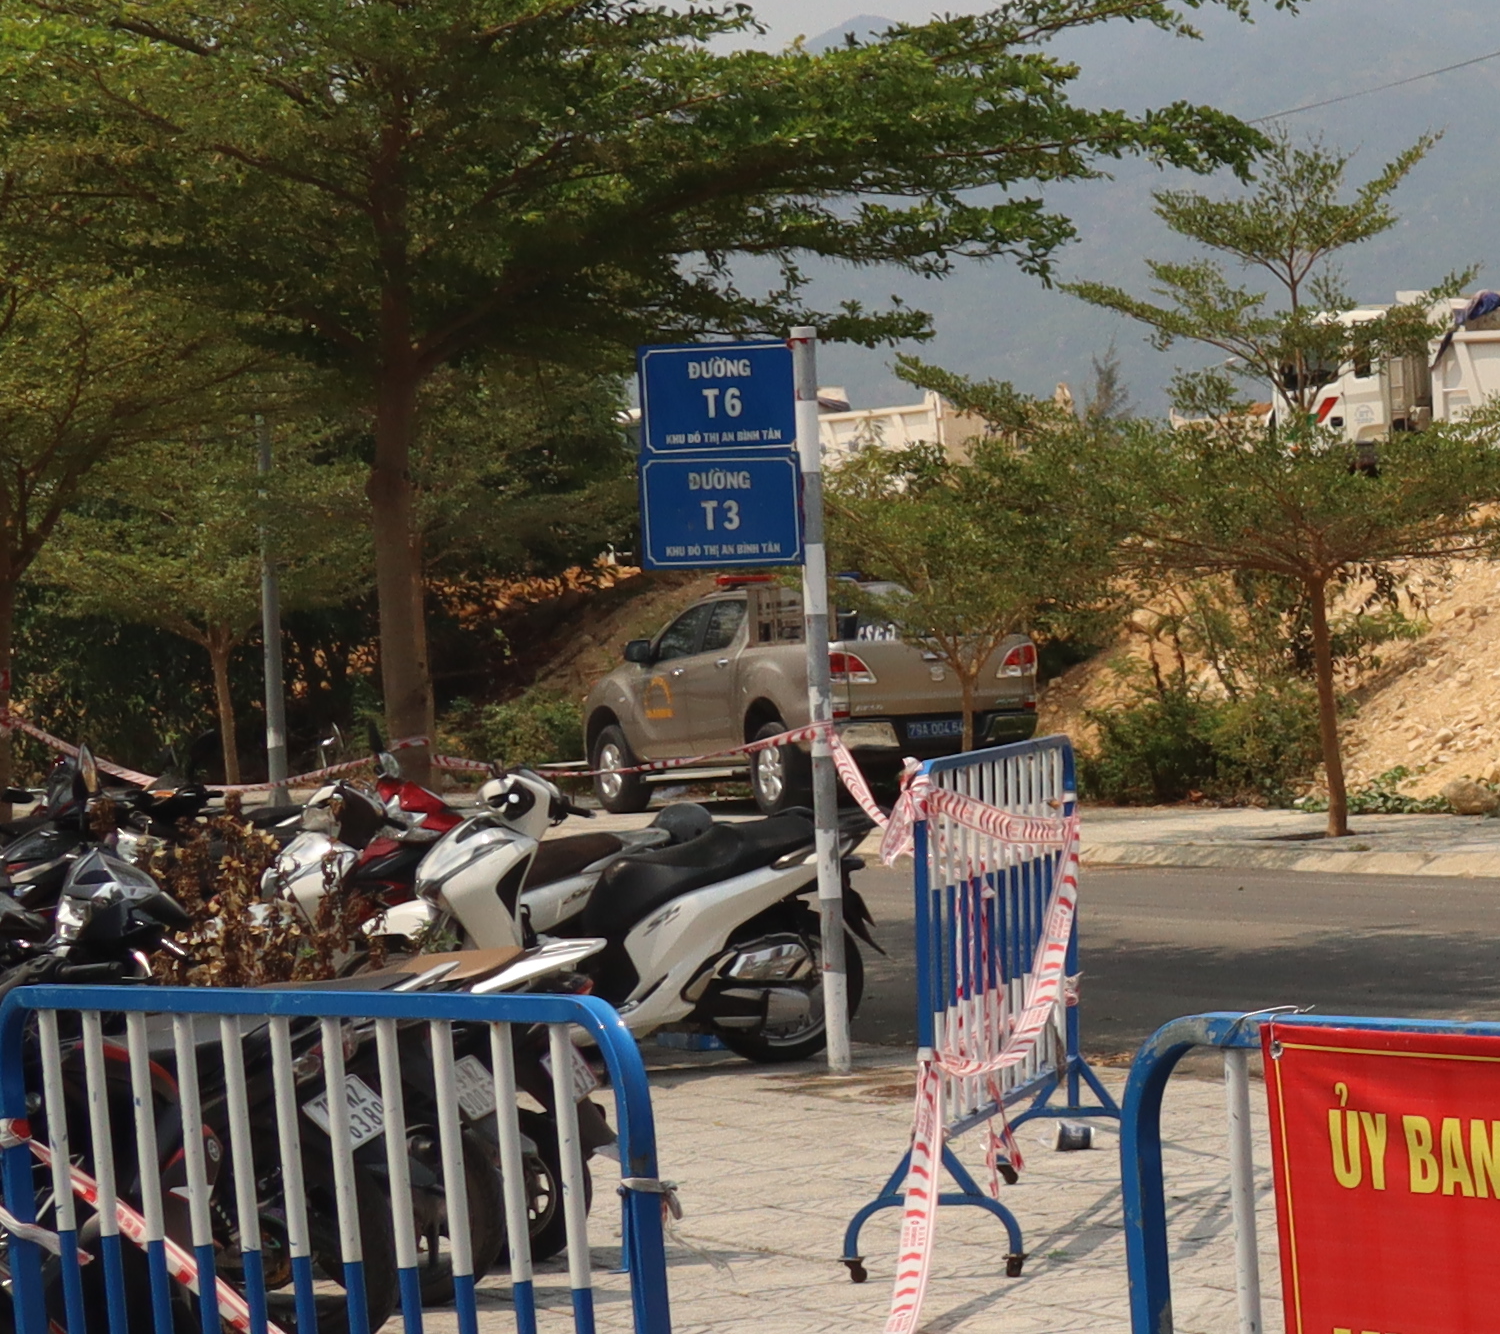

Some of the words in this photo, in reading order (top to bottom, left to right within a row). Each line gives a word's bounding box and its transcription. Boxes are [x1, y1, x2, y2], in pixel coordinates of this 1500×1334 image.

[688, 356, 751, 379] ĐƯỜNG
[666, 434, 685, 445] KHU
[721, 431, 735, 442] AN
[688, 468, 751, 490] ĐƯỜNG
[666, 546, 685, 557] KHU
[721, 544, 735, 555] AN
[1327, 1081, 1388, 1191] ỦY
